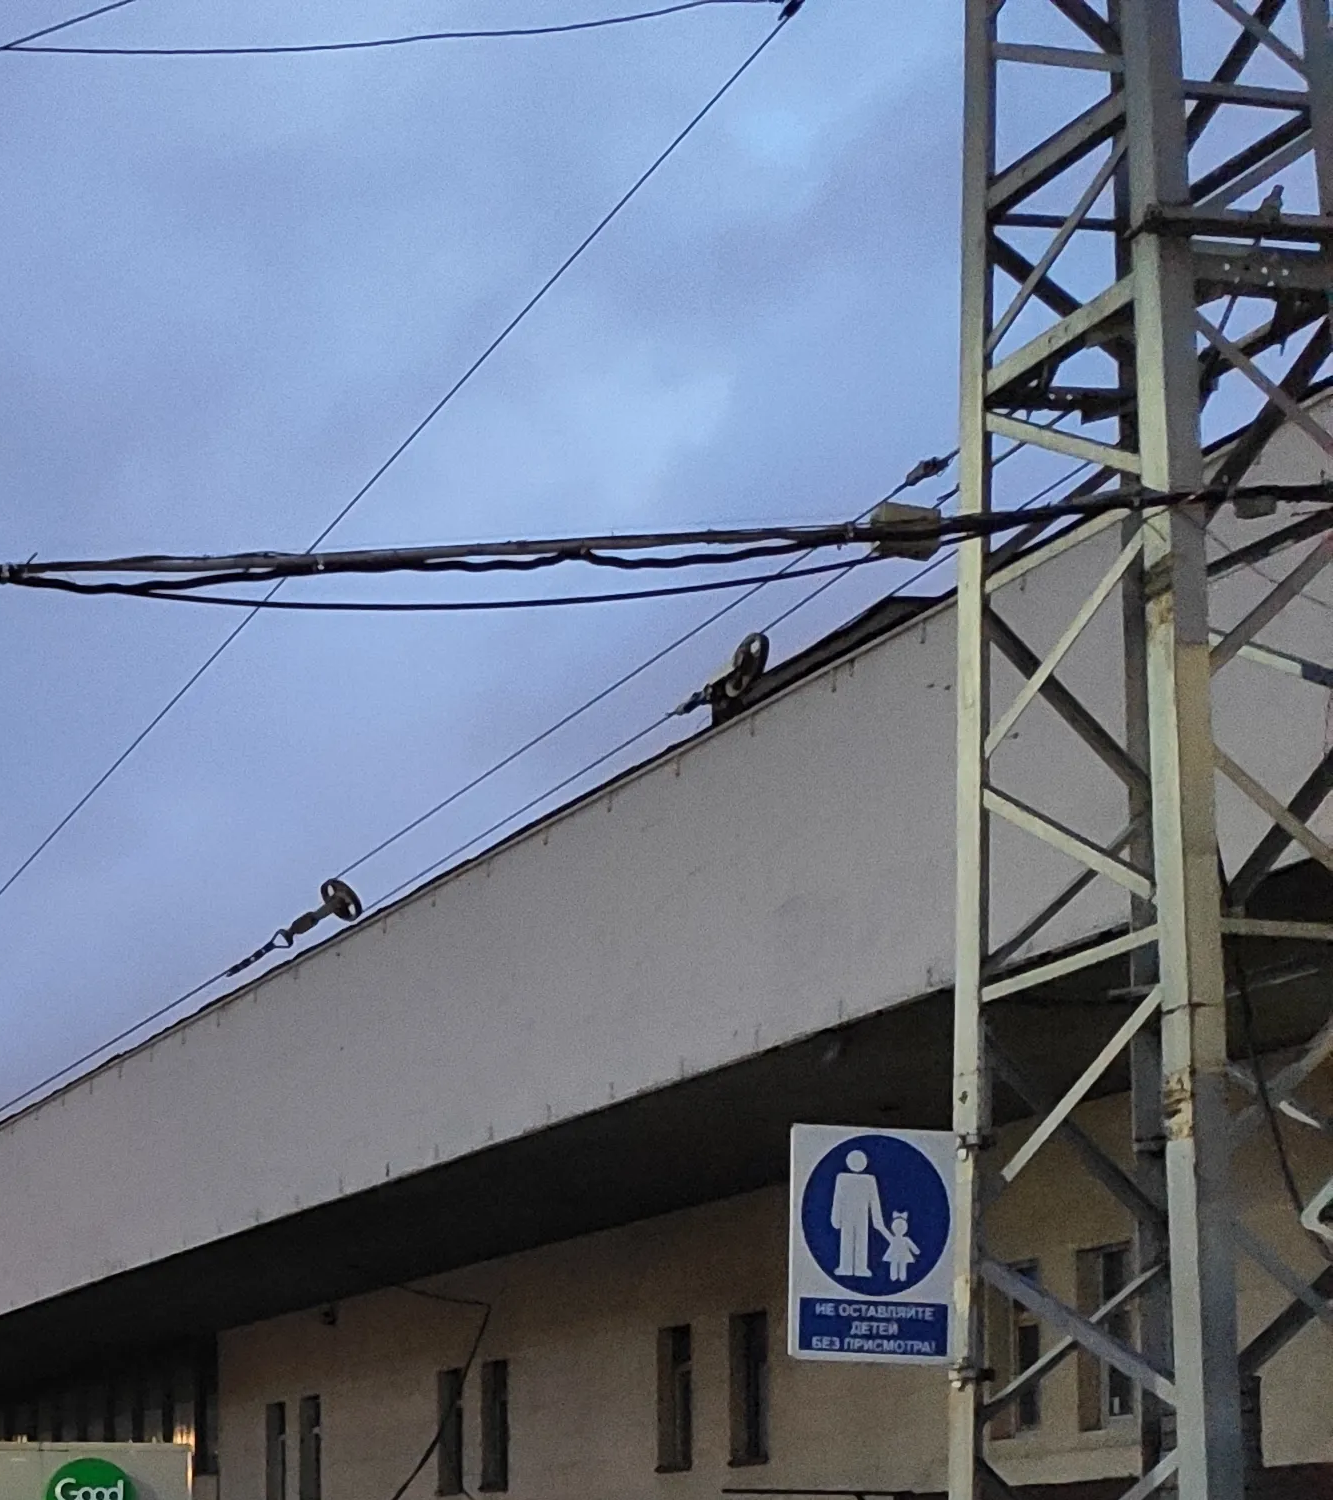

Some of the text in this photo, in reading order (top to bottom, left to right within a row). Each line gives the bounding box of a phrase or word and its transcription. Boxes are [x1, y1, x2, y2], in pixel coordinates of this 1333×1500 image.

[815, 1303, 935, 1321] НЕ ОСТАВЛЯЙТЕ
[849, 1320, 899, 1336] ДЕТЕЙ
[811, 1335, 936, 1354] БЕЗ ПРИСМОТРА!
